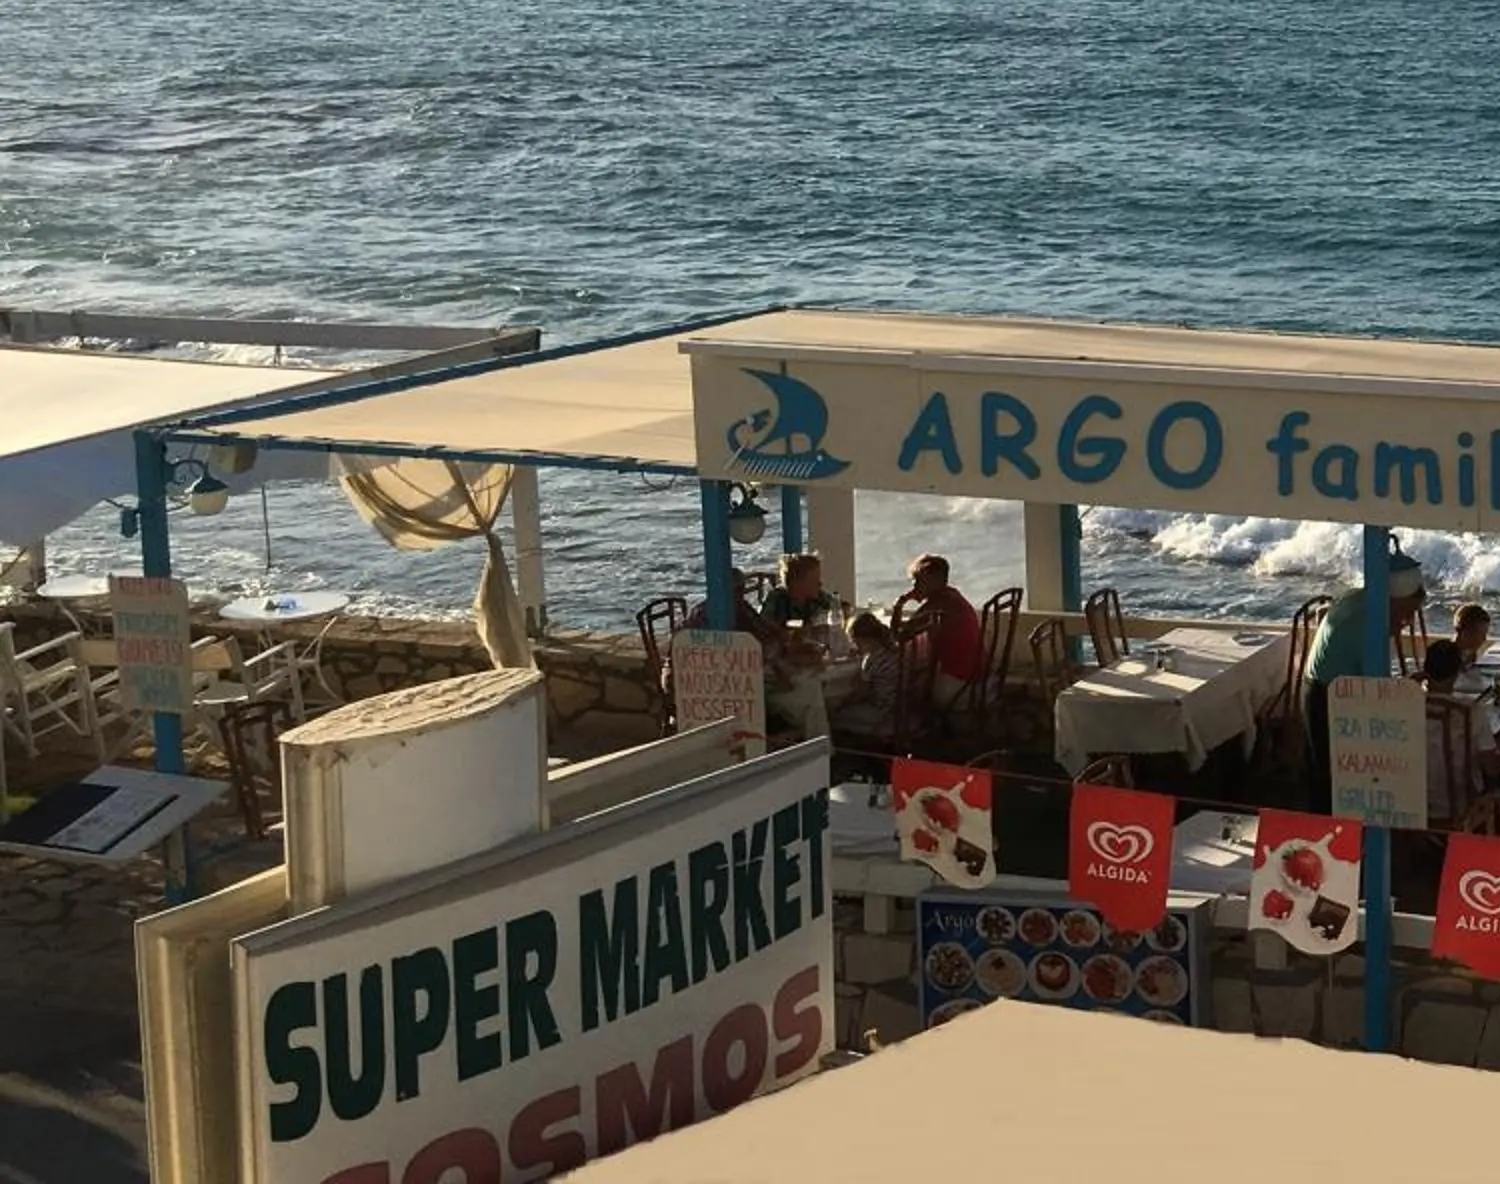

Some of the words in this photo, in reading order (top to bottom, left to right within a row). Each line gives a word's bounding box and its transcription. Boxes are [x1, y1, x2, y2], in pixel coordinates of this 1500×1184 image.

[896, 390, 1224, 491] ARGO
[1087, 863, 1149, 884] ALGIDA
[263, 909, 562, 1143] SUPER
[579, 786, 830, 1034] MARKET
[320, 963, 824, 1184] SMOS
